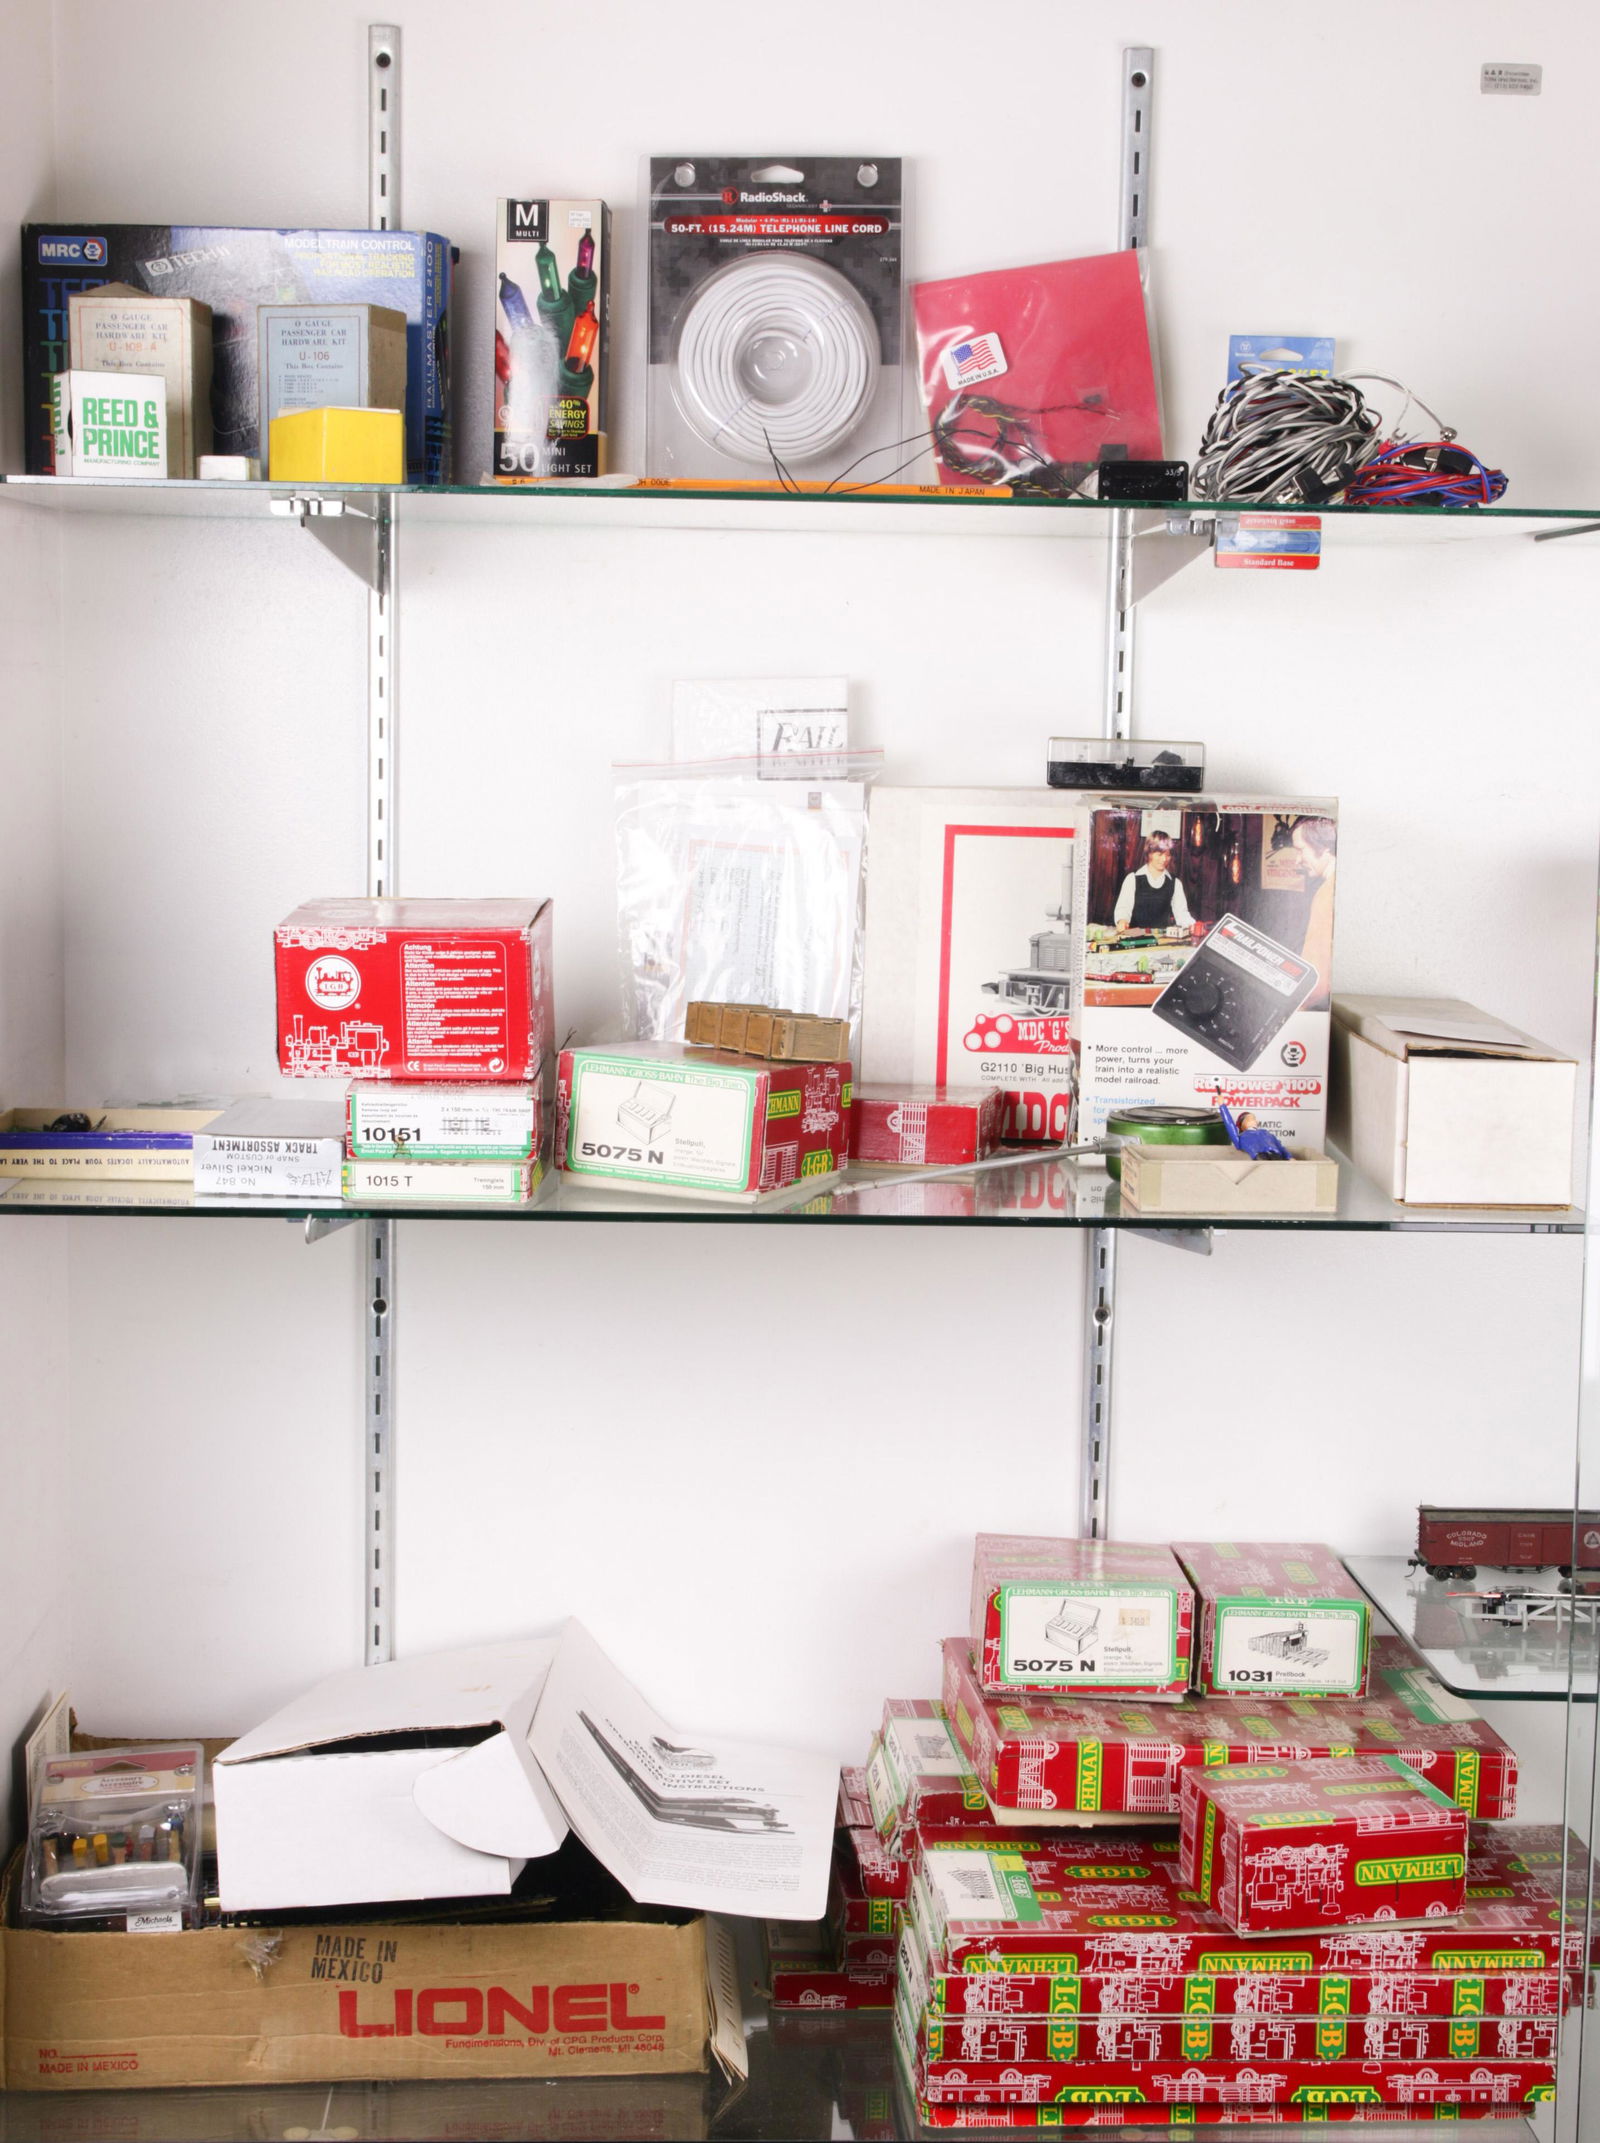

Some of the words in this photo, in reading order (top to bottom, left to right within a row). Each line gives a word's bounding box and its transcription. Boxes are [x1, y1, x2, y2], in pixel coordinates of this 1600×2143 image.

[741, 192, 805, 202] RadioShack
[516, 204, 538, 226] M
[672, 224, 705, 233] 50-FT.
[709, 224, 756, 233] (15.24M)
[760, 224, 821, 233] TELEPHONE
[825, 224, 848, 233] LINE
[852, 224, 882, 233] CORD
[41, 243, 80, 258] MRC
[284, 239, 323, 250] MODEL
[325, 239, 359, 250] TRAIN
[361, 240, 415, 250] CONTROL
[82, 397, 138, 427] REED
[144, 401, 159, 428] &
[550, 410, 586, 419] ENERGY
[550, 420, 584, 428] SAVINGS
[83, 429, 159, 459] PRINCE
[500, 443, 538, 472] 50
[542, 463, 570, 472] LIGHT
[575, 464, 592, 473] SET
[919, 487, 940, 495] MADE
[945, 487, 954, 495] IN
[959, 487, 985, 496] JAPAN
[1018, 1022, 1045, 1040] MDC
[1095, 1045, 1118, 1053] More
[1121, 1045, 1152, 1054] control
[980, 1062, 1017, 1072] G2110
[1095, 1056, 1125, 1065] power,
[1128, 1056, 1150, 1064] turns
[1154, 1058, 1173, 1066] your
[1095, 1066, 1115, 1074] train
[1118, 1066, 1135, 1074] into
[1146, 1066, 1180, 1075] realistic
[1094, 1076, 1122, 1084] model
[1125, 1076, 1160, 1085] railroad.
[1094, 1096, 1156, 1105] Transistorized
[362, 1127, 421, 1142] 10151
[212, 1140, 280, 1152] ASSORTMENT
[285, 1142, 317, 1154] TRACK
[226, 1154, 263, 1162] CUSTOM
[582, 1143, 642, 1162] 5075
[648, 1151, 664, 1164] N
[200, 1163, 233, 1173] Silver
[237, 1164, 272, 1174] Nickel
[216, 1176, 236, 1185] 847
[366, 1176, 399, 1187] 1015
[404, 1176, 412, 1187] T
[1446, 1531, 1487, 1539] COLORADO
[1451, 1540, 1484, 1548] MIDLAND
[1013, 1660, 1073, 1672] 5075
[1080, 1660, 1095, 1672] N
[1229, 1670, 1273, 1682] 1031
[1360, 1859, 1460, 1882] LEHMANN
[135, 1914, 172, 1926] Michaels
[315, 1934, 366, 1960] MADE
[378, 1940, 397, 1962] IN
[970, 1957, 1074, 1973] LEHMANN
[1204, 1956, 1308, 1972] LEHMANN
[1437, 1954, 1542, 1970] LEHMANN
[311, 1957, 383, 1984] MEXICO
[339, 1982, 665, 2038] LIONEL
[445, 2038, 524, 2049] Fundimensions,
[528, 2037, 545, 2048] Div.
[550, 2037, 560, 2046] of
[563, 2036, 587, 2045] CPG
[591, 2034, 635, 2044] Products
[548, 2047, 564, 2057] Mt.
[568, 2046, 614, 2056] Clemens,
[618, 2045, 631, 2054] MI
[39, 2062, 74, 2073] MADE
[77, 2062, 89, 2071] IN
[93, 2059, 138, 2071] MEXICO
